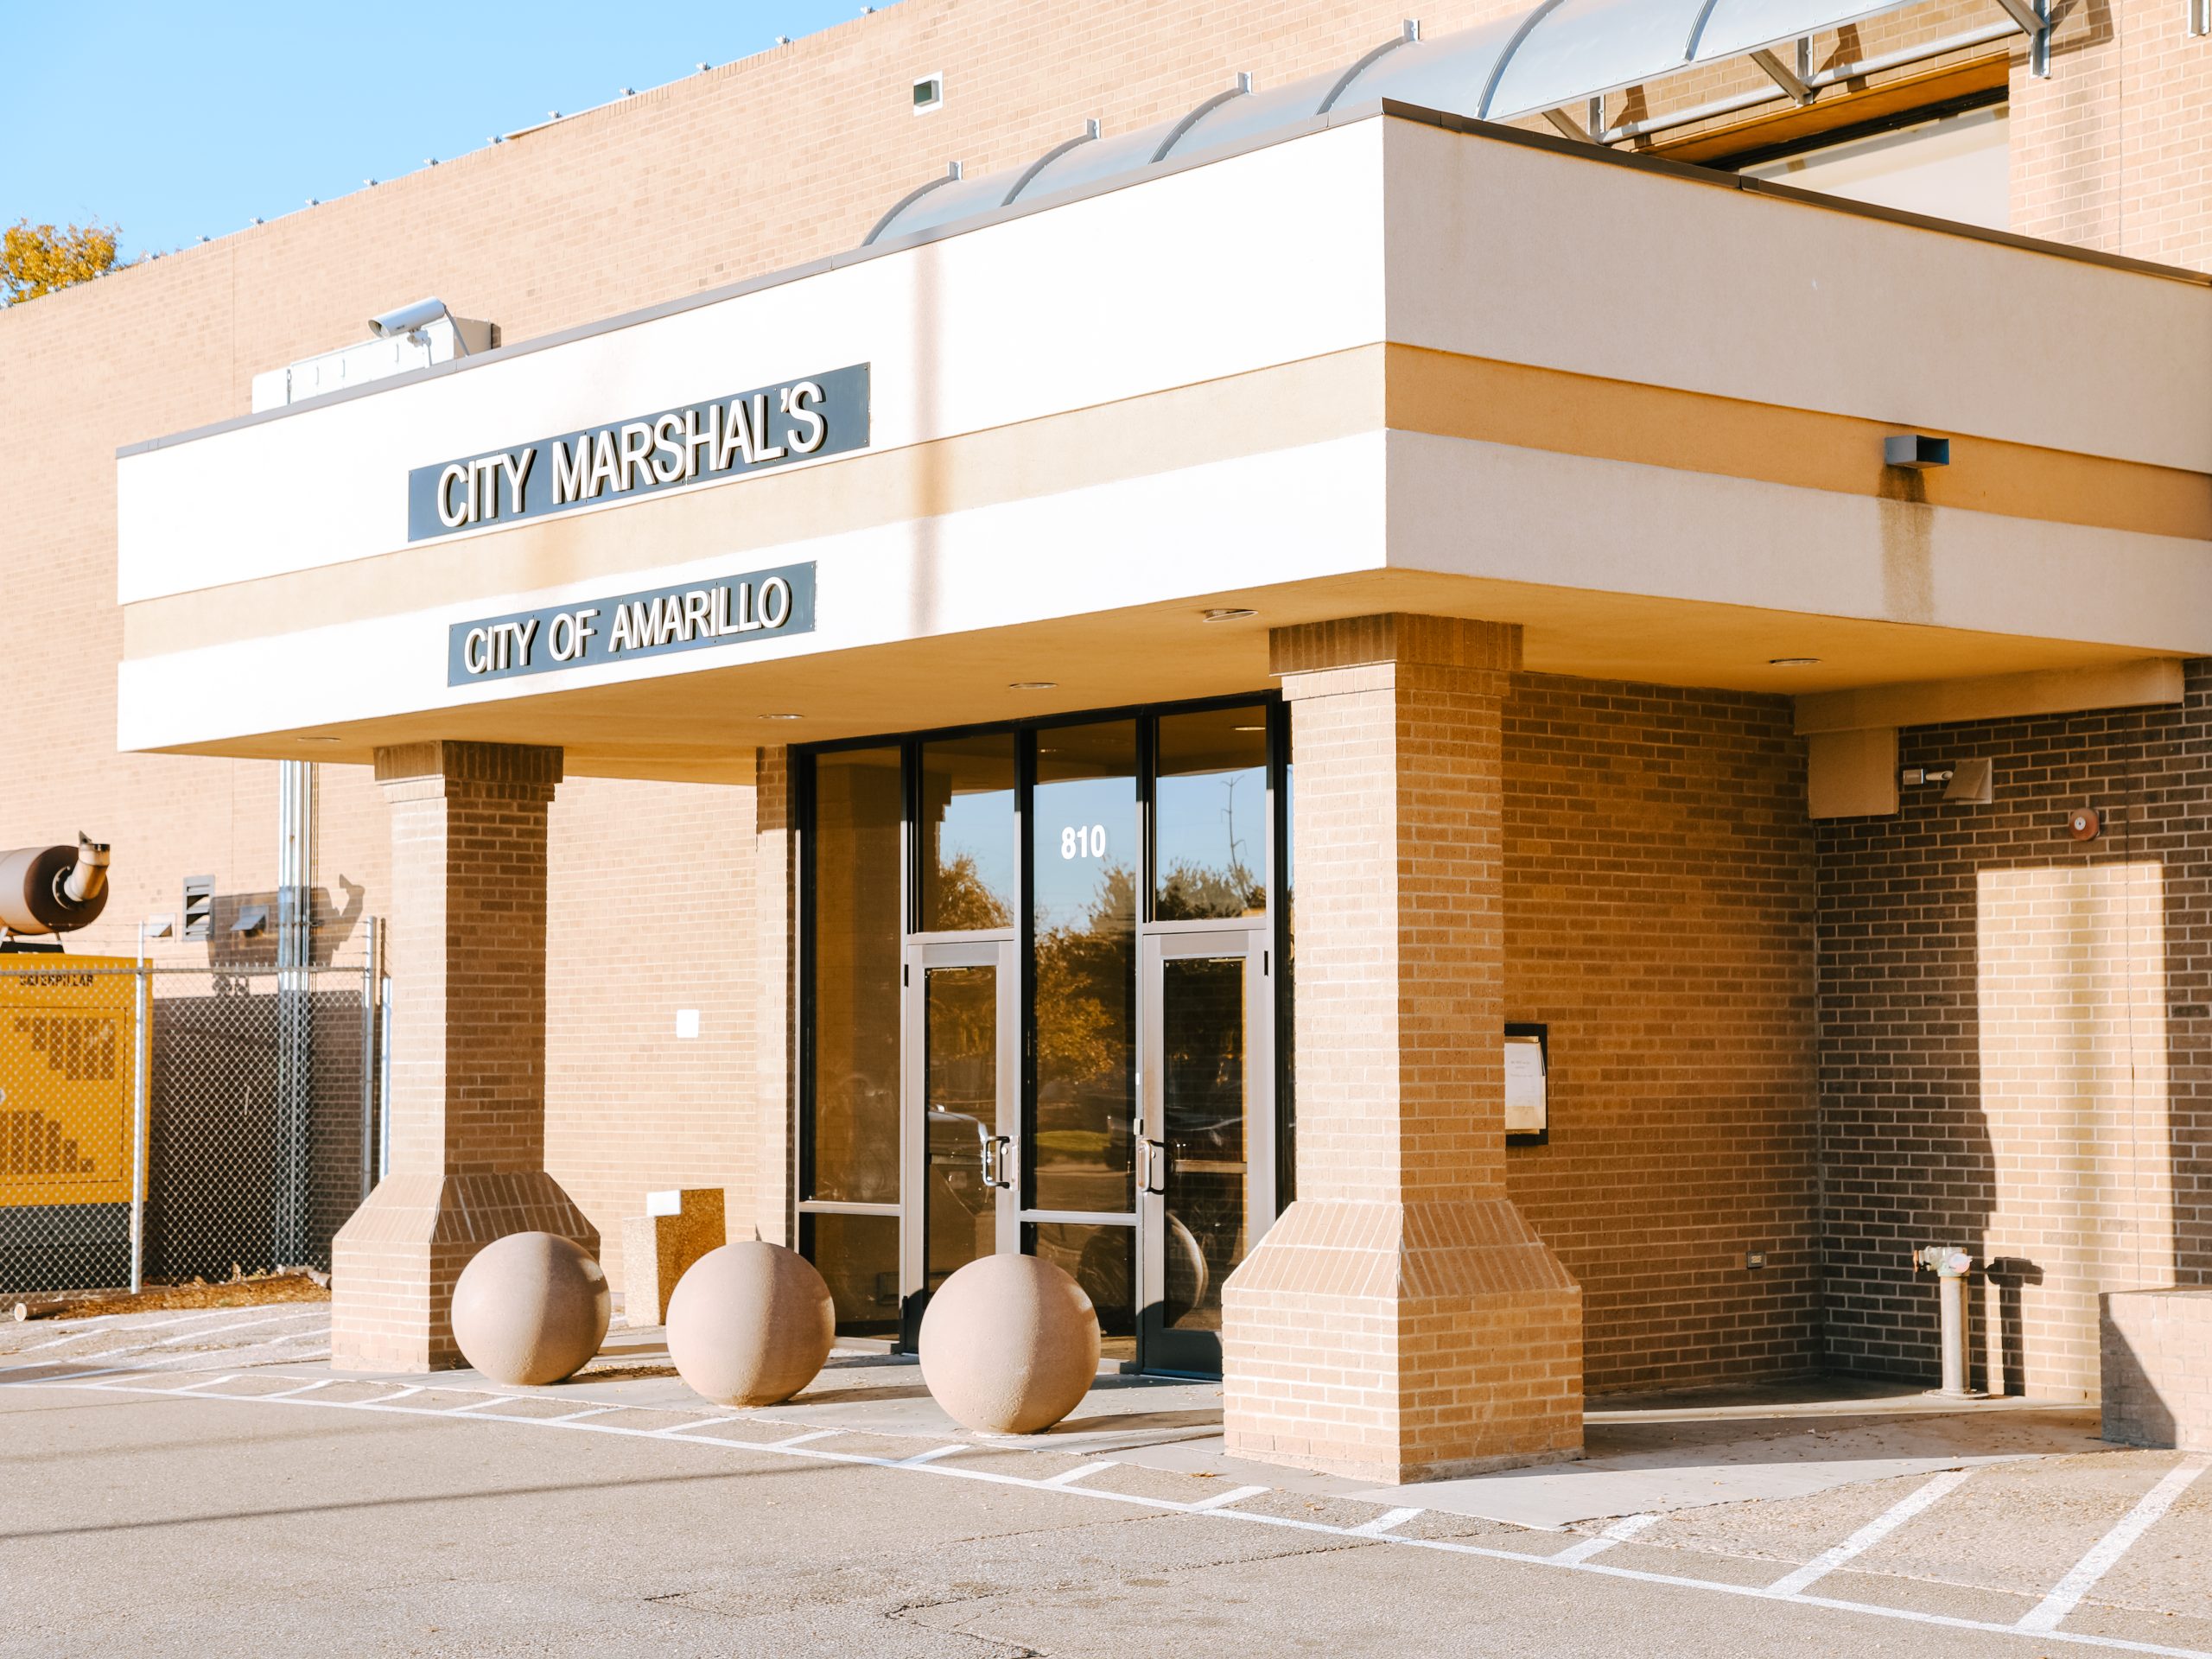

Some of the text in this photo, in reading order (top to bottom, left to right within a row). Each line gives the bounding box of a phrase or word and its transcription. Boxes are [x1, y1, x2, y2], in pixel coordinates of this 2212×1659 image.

[437, 381, 826, 527] CITY MARSHAL'S
[463, 576, 791, 674] CITY OF AMARILLO
[1061, 824, 1106, 860] 810
